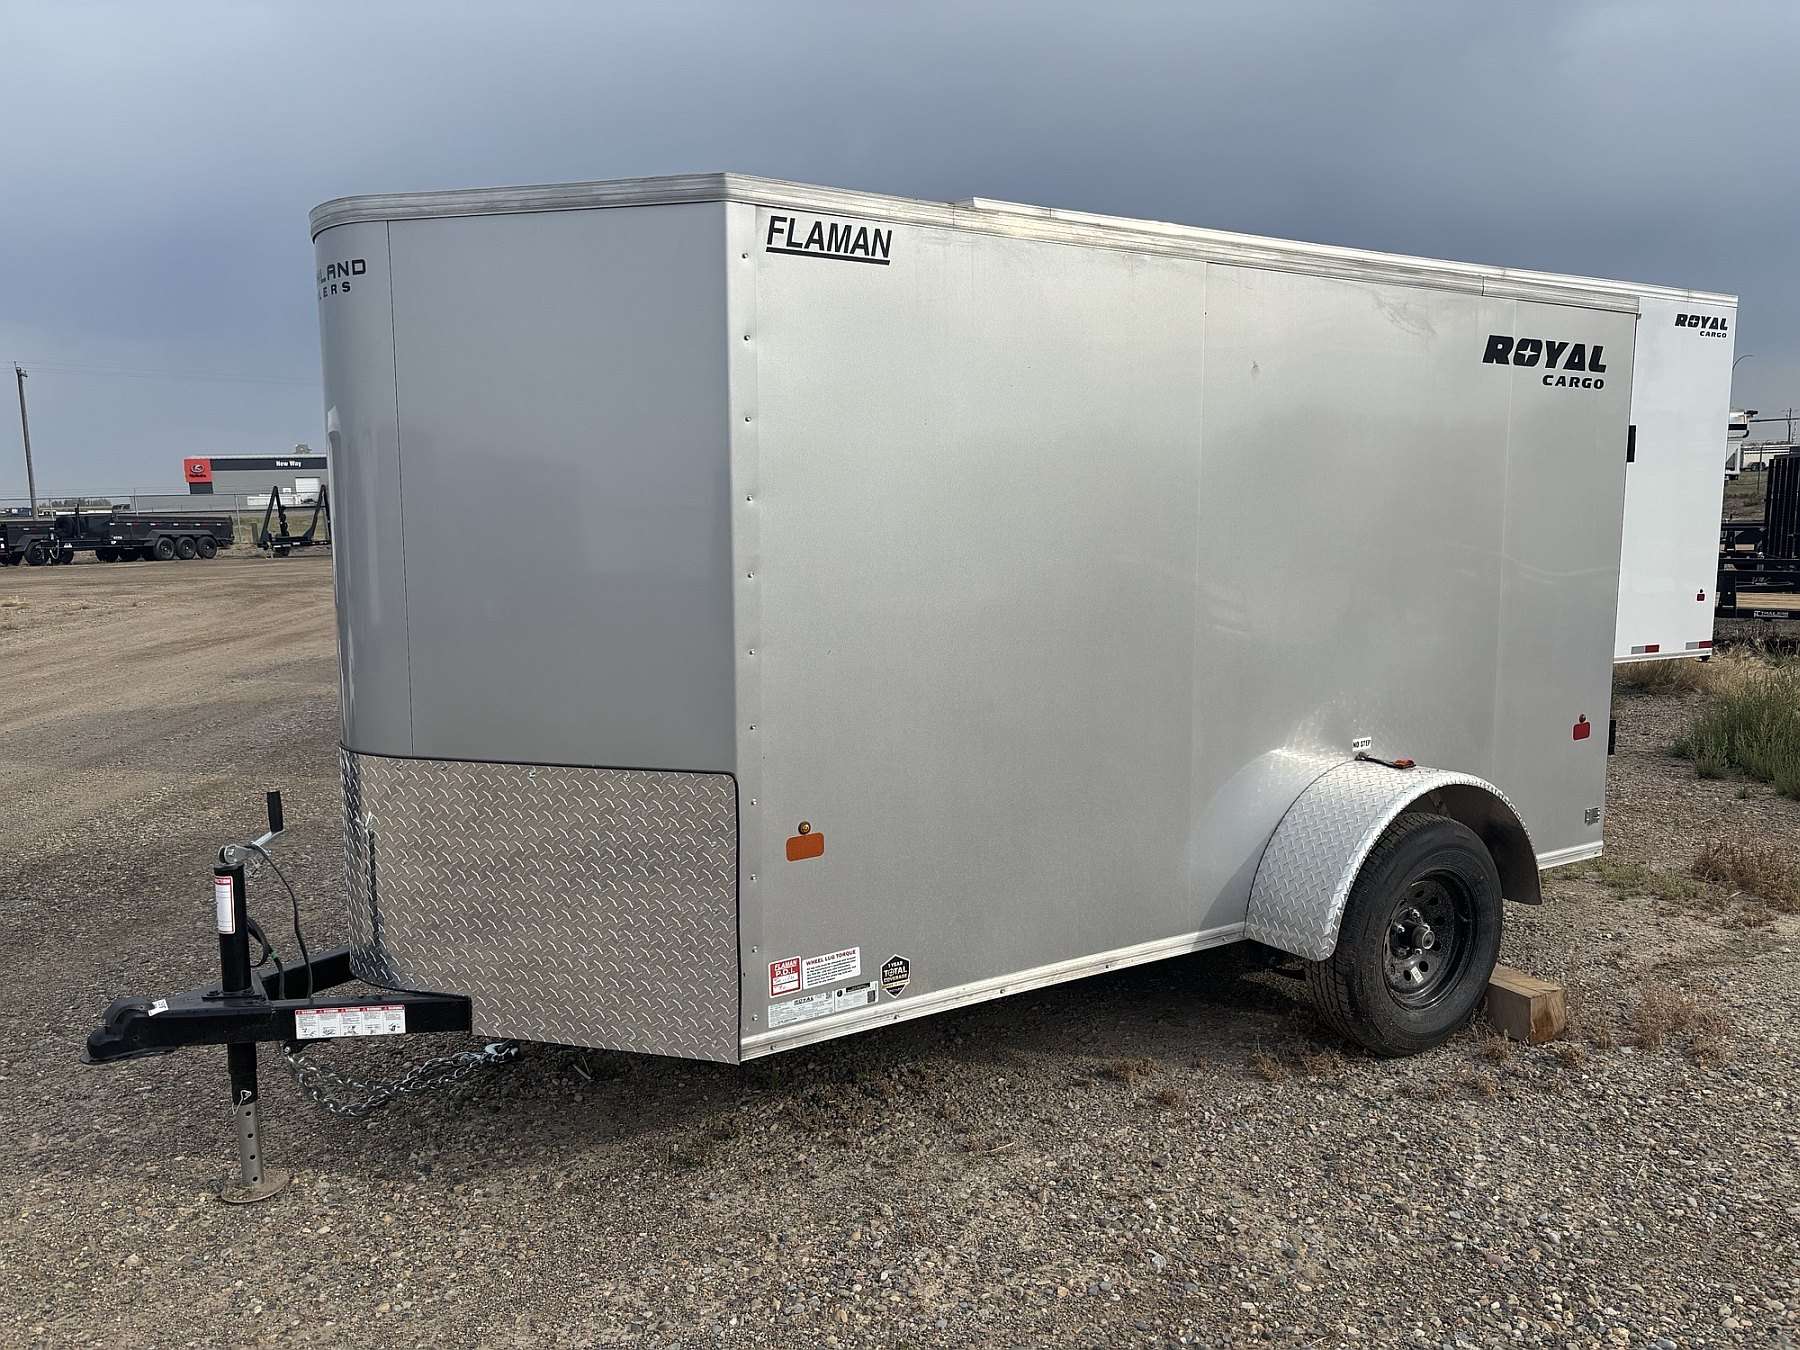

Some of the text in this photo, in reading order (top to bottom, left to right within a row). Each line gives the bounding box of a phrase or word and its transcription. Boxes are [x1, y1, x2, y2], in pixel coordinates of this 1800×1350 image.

[766, 215, 893, 258] FLAMAN
[318, 259, 366, 283] LAND
[320, 281, 351, 300] ERS
[1675, 313, 1728, 330] ROYAL
[1482, 335, 1607, 373] ROYAL
[1542, 374, 1604, 389] CARGO
[289, 460, 301, 468] Way
[806, 949, 856, 966] WHEEL LUG TORQUE
[883, 966, 908, 977] TOTAL
